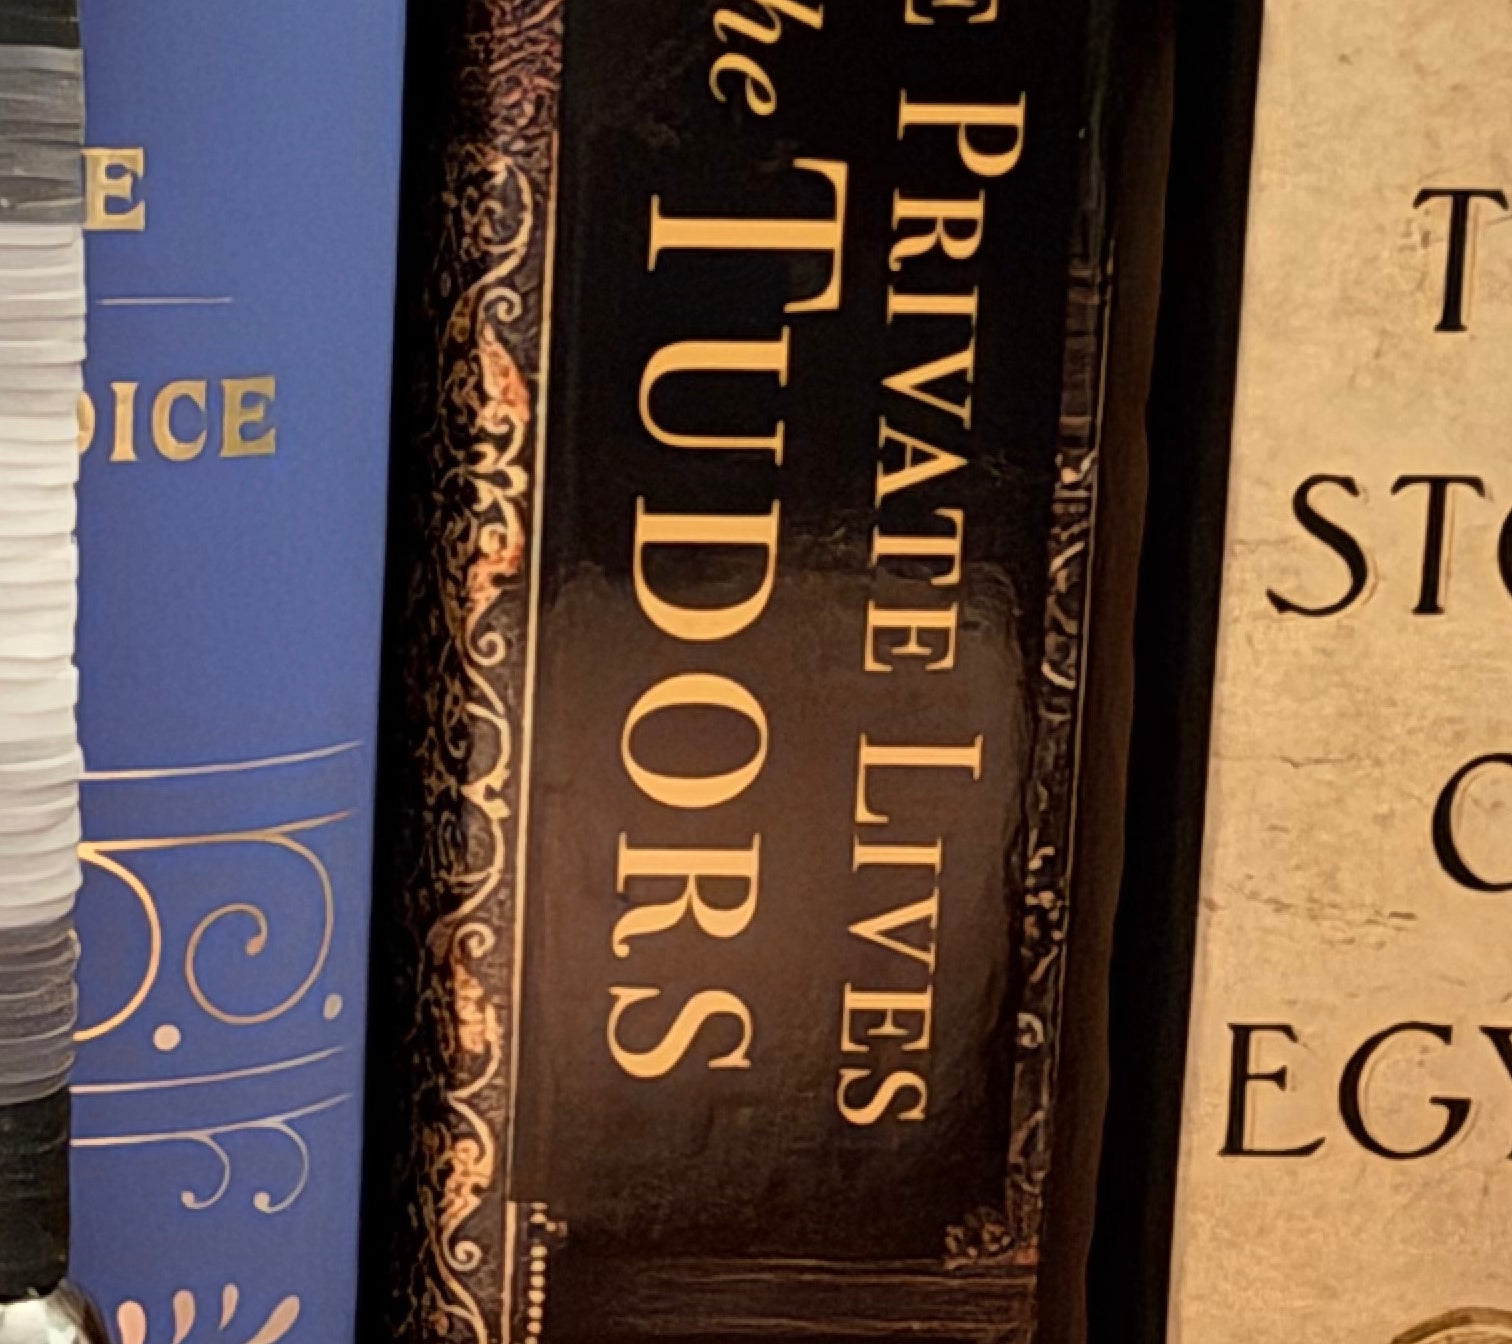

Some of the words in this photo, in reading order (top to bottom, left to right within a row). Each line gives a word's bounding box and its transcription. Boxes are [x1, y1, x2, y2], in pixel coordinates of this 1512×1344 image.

[606, 157, 849, 1080] TUDORS
[864, 89, 1026, 672] PRIVATE
[1266, 474, 1512, 618] ST
[836, 733, 984, 1125] LIVES
